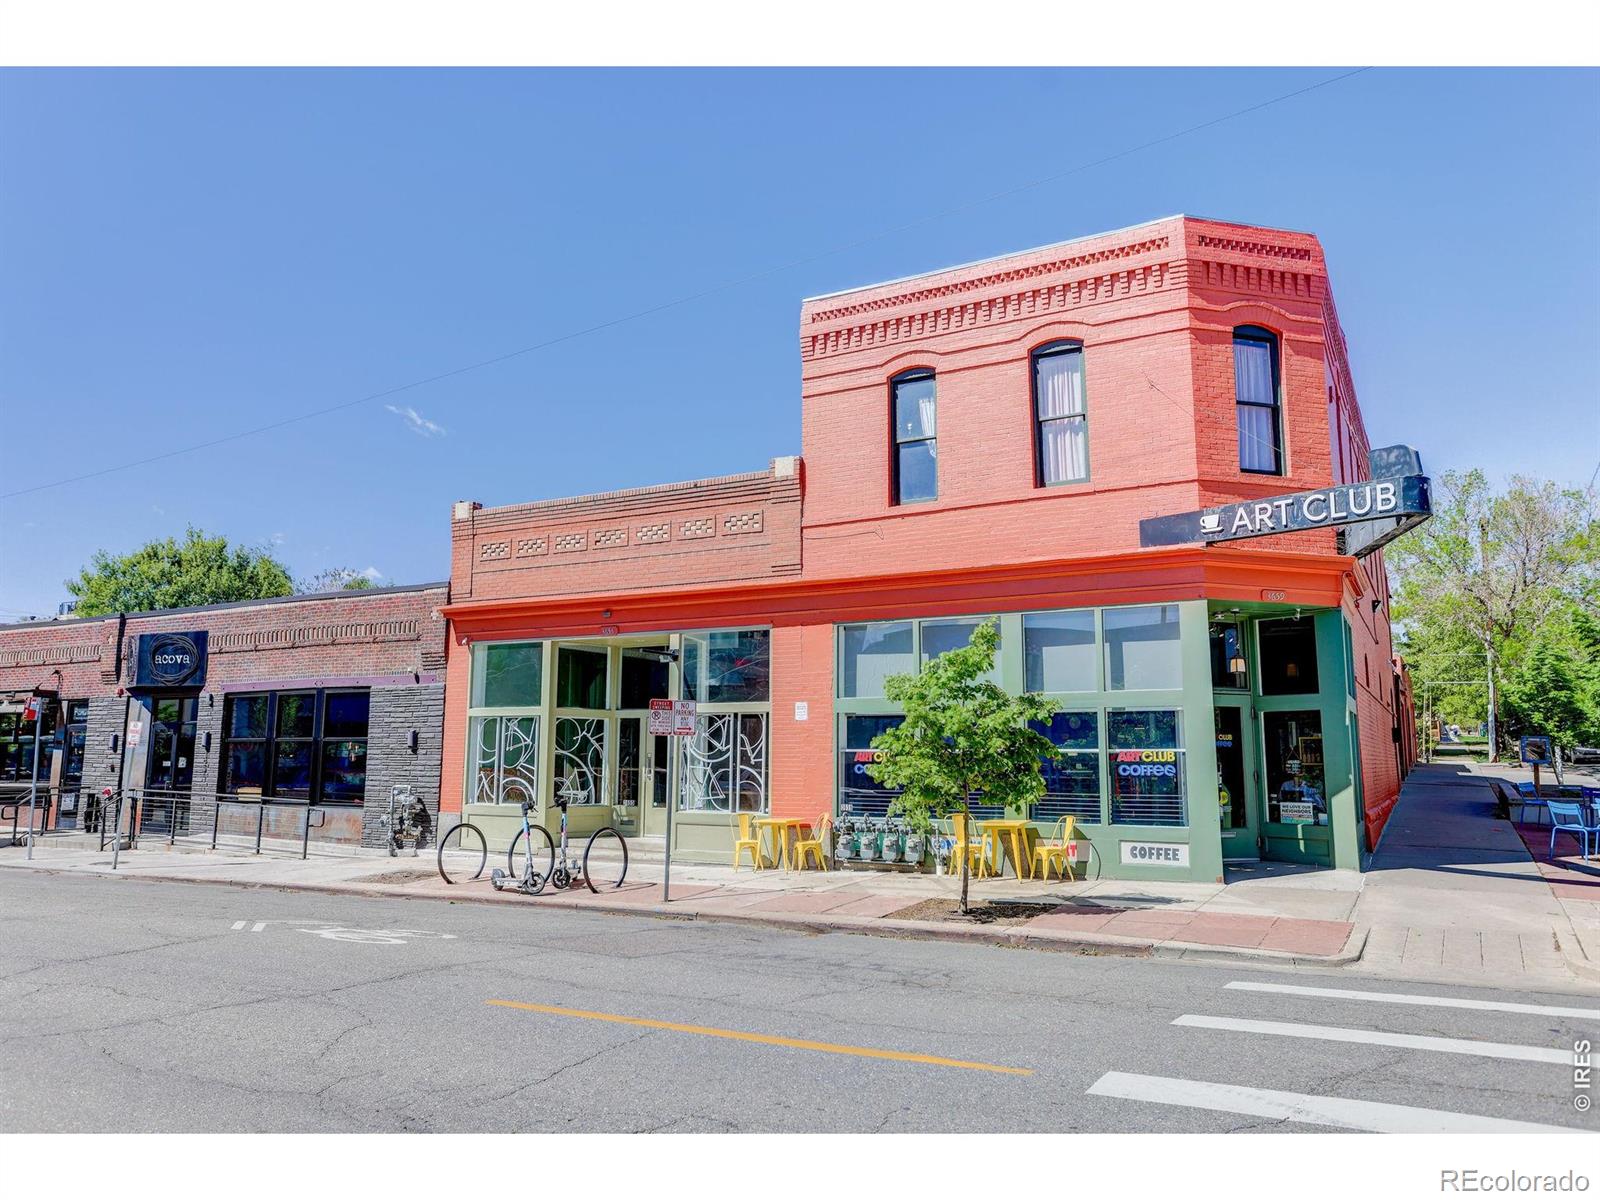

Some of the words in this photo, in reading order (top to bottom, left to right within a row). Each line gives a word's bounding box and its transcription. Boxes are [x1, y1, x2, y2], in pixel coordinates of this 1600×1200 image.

[1231, 499, 1293, 534] ART
[1302, 483, 1397, 522] CLUB
[154, 654, 190, 664] acova
[680, 702, 690, 710] NO
[675, 709, 695, 717] PARKING
[854, 751, 872, 761] ART
[1117, 751, 1141, 762] ART
[1141, 751, 1176, 762] CLUB
[1129, 845, 1180, 861] COFFEE
